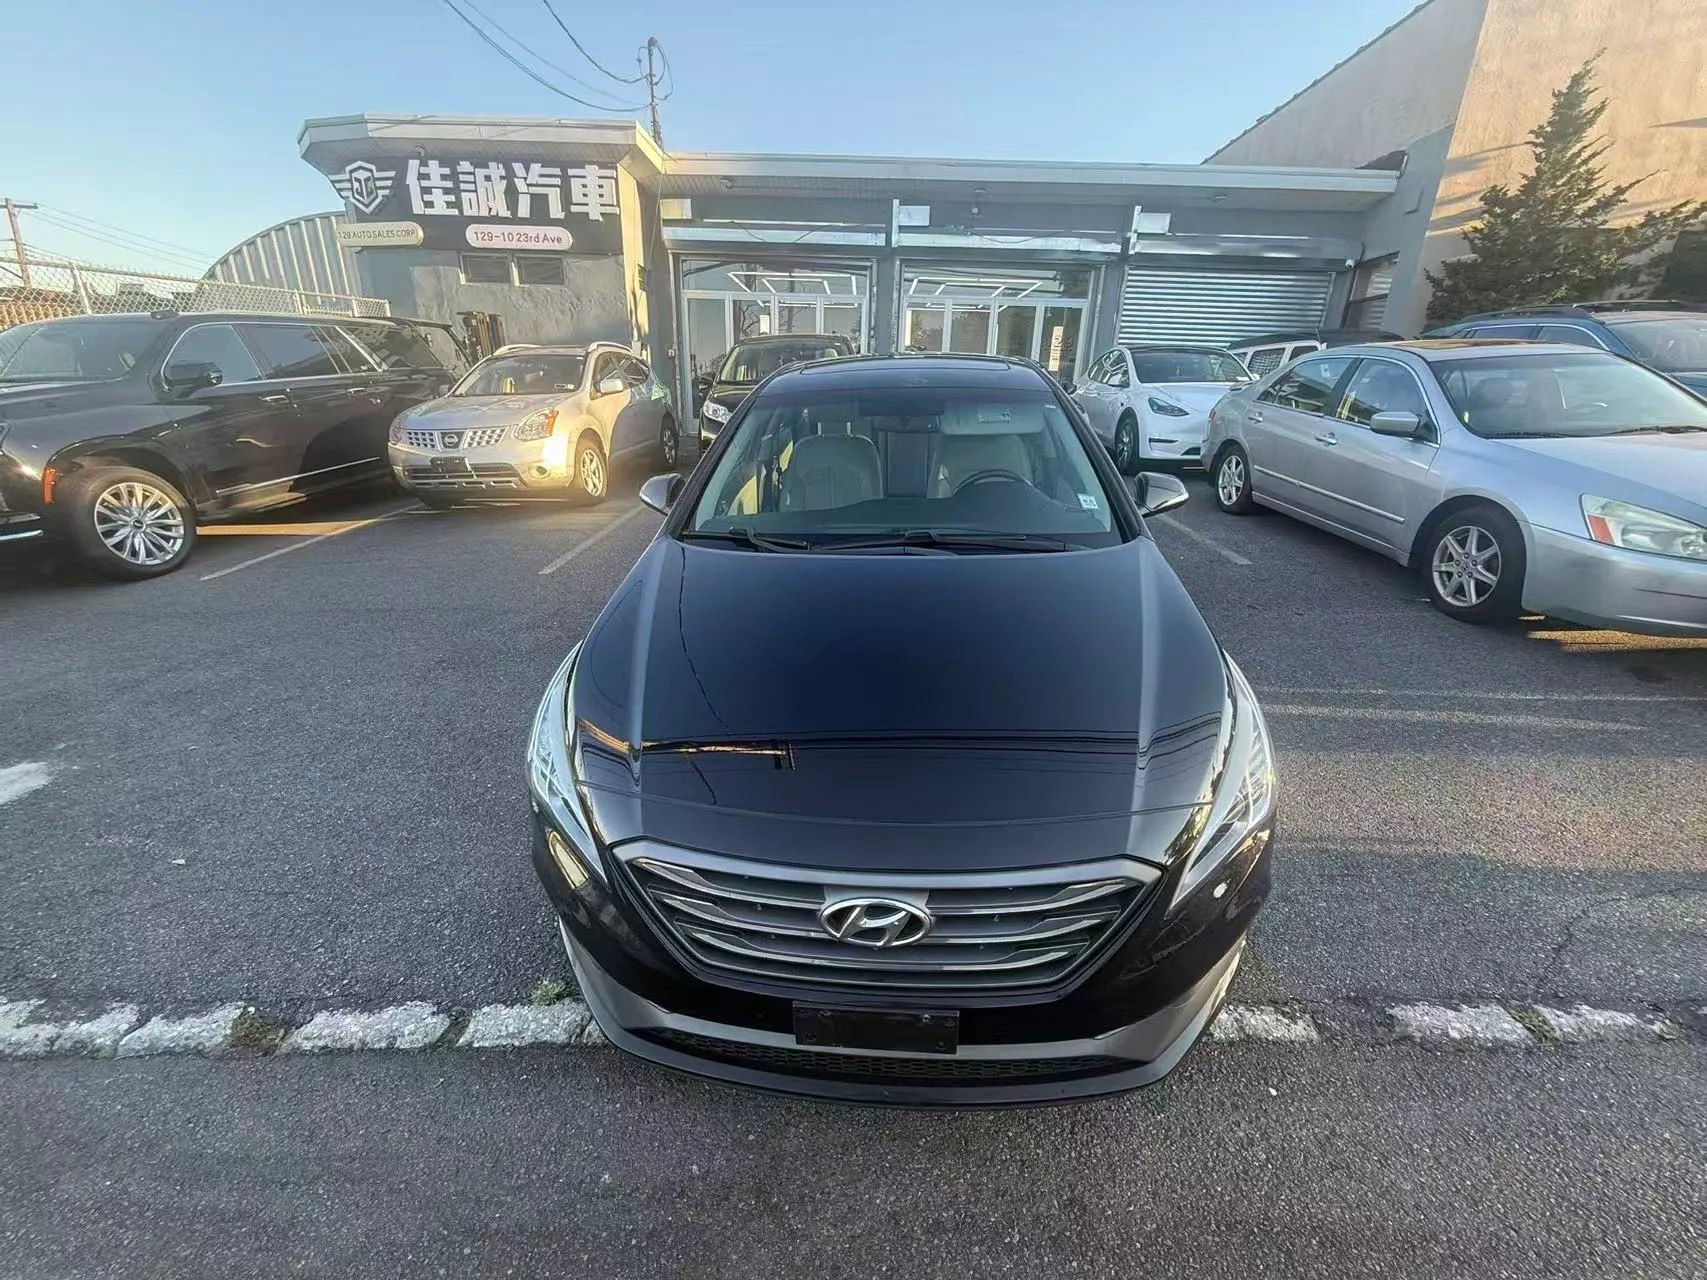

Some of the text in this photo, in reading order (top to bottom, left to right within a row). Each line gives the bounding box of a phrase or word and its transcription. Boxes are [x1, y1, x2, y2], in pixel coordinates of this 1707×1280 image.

[406, 159, 620, 222] 佳誠汽車
[338, 229, 416, 240] 129 AUTO SALES CORP
[474, 231, 563, 244] 129-10 23rd Ave
